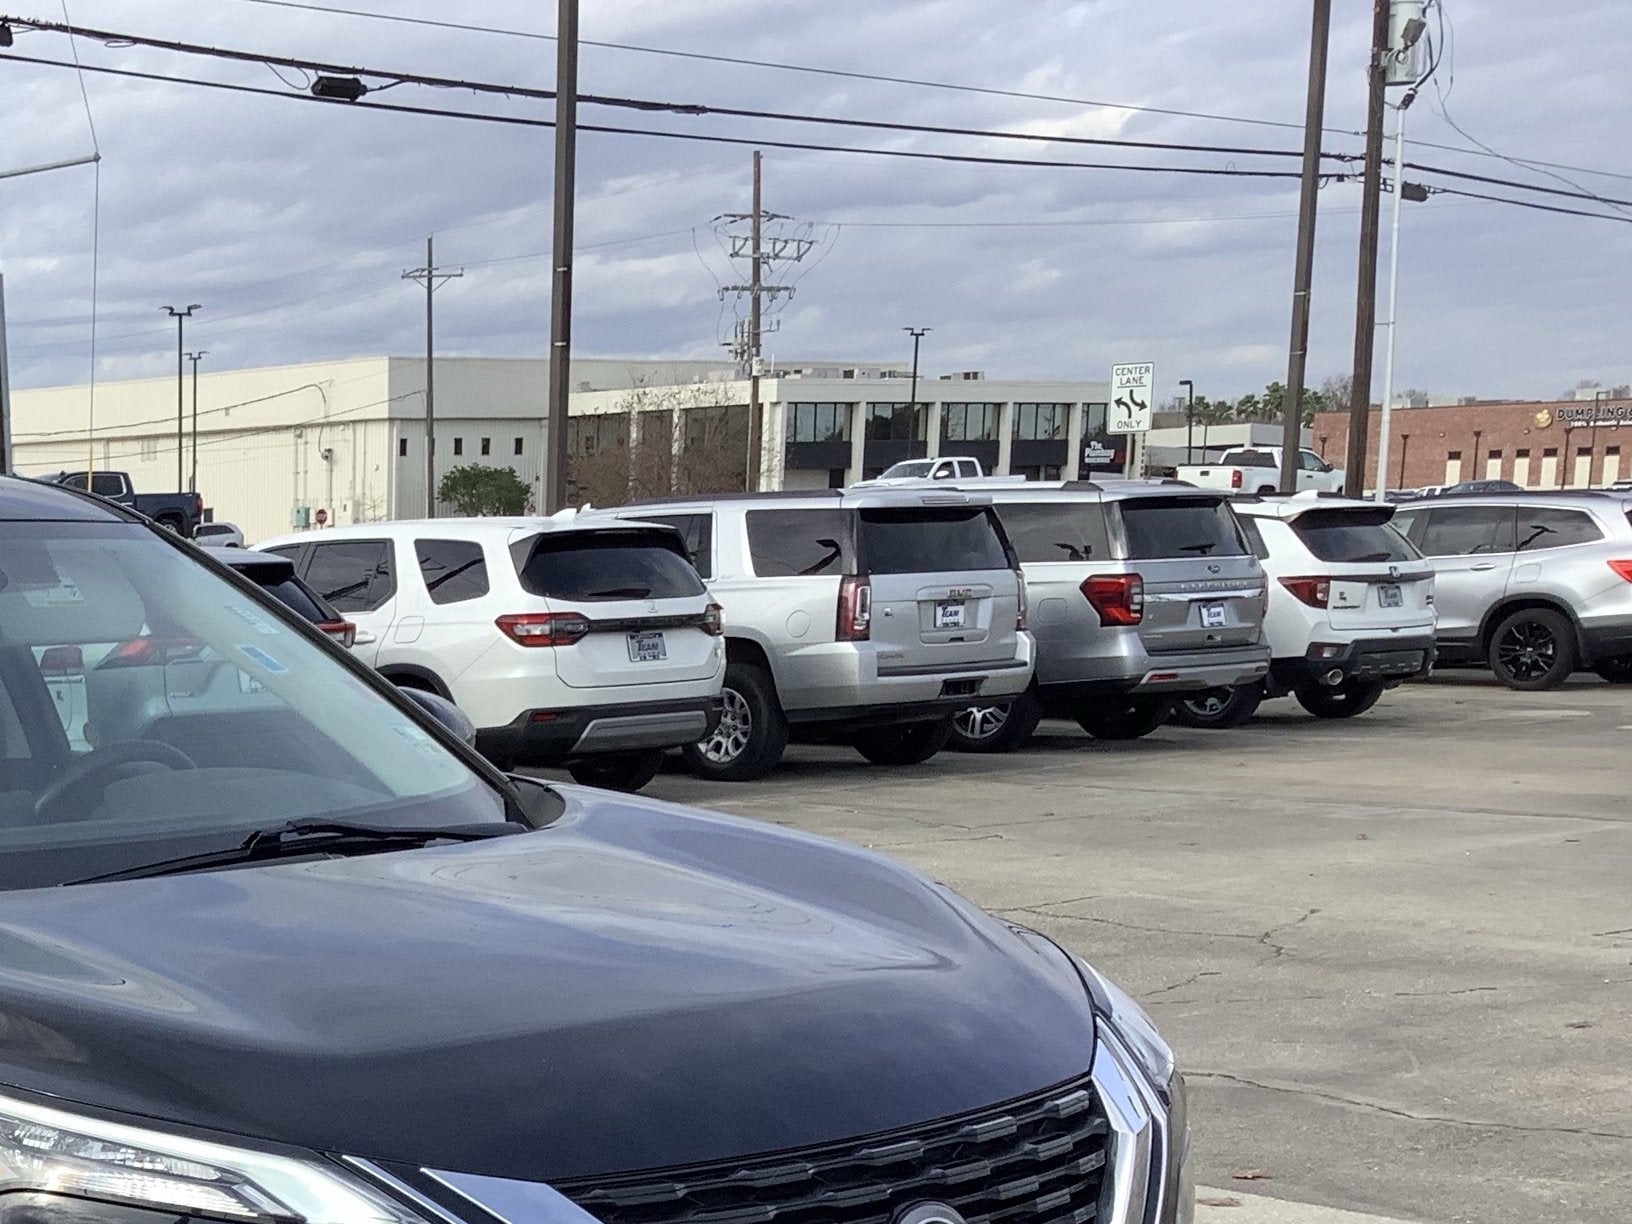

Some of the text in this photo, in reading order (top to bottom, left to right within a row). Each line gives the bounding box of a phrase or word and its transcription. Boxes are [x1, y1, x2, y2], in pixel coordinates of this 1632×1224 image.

[1115, 366, 1151, 376] CENTER
[1119, 376, 1144, 386] LANE
[1117, 420, 1142, 429] ONLY
